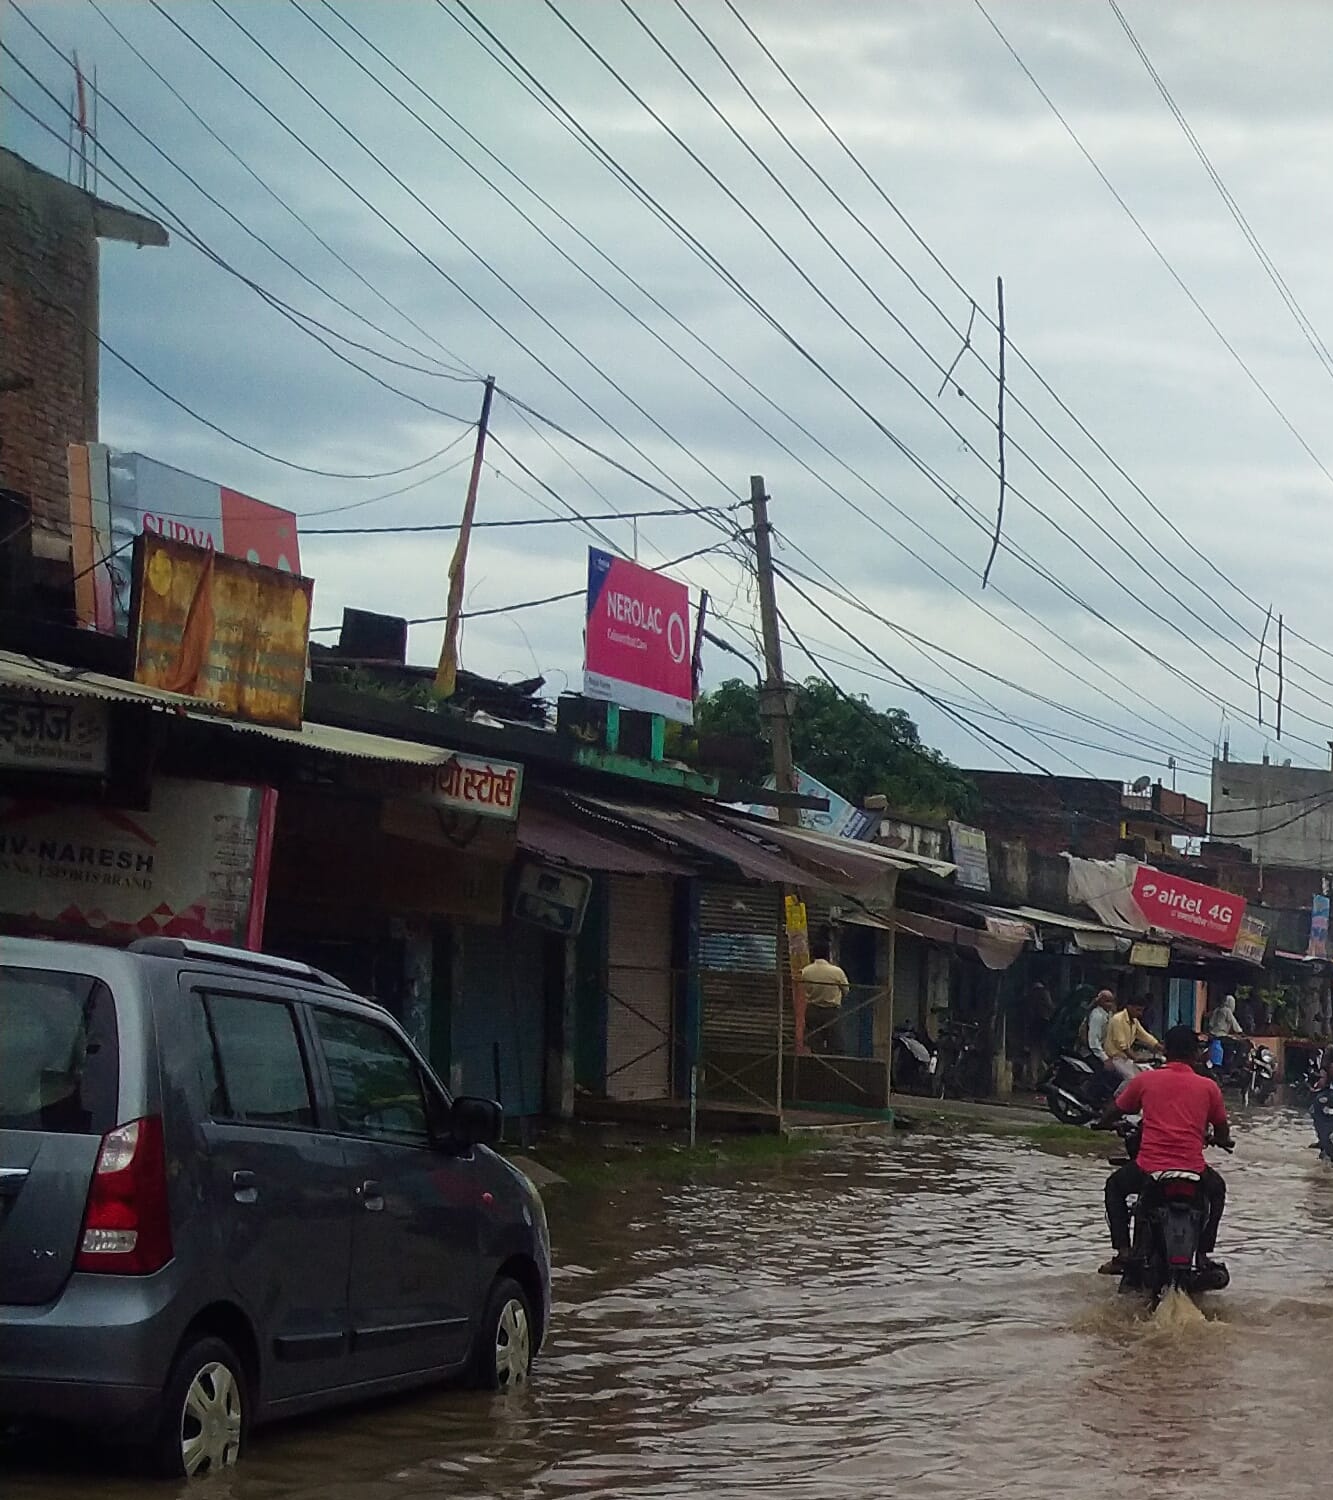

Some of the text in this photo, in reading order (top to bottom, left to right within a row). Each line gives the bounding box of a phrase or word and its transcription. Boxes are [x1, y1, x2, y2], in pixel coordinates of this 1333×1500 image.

[607, 591, 664, 635] NEROLAC
[463, 765, 517, 807] स्टोर्स
[103, 873, 153, 891] BRAND
[1158, 888, 1201, 914] airtel
[1208, 904, 1233, 923] 4G
